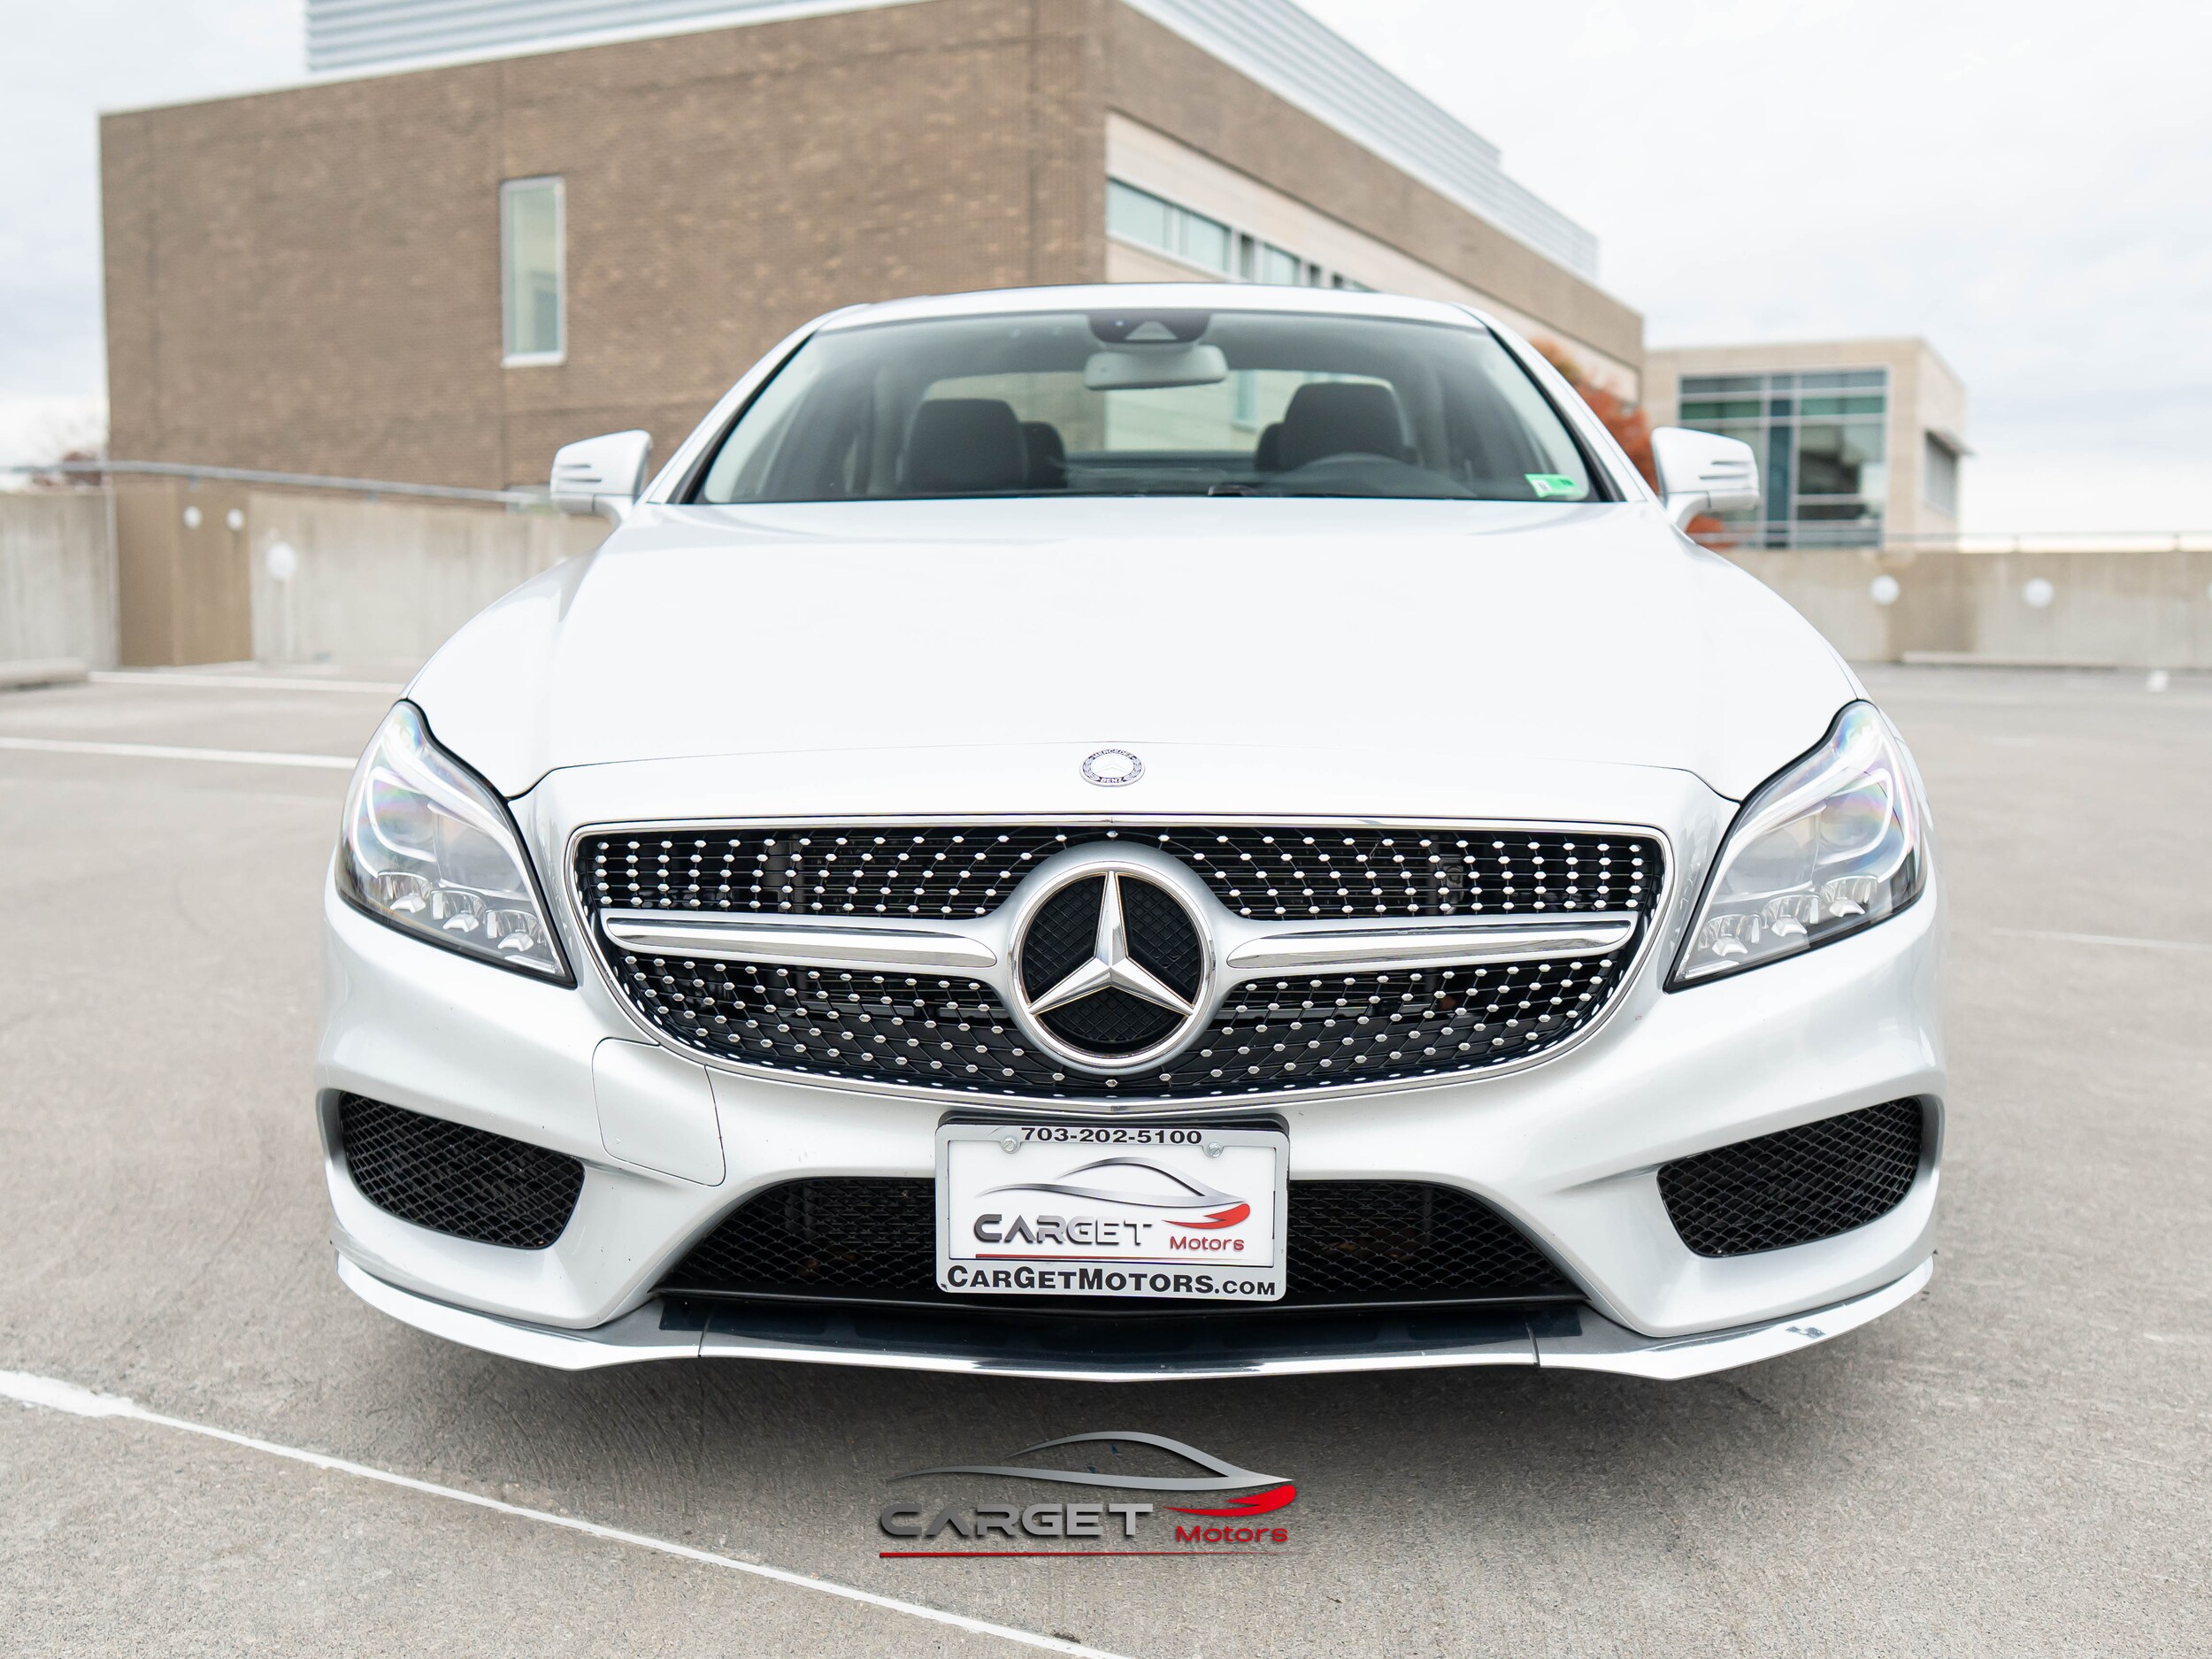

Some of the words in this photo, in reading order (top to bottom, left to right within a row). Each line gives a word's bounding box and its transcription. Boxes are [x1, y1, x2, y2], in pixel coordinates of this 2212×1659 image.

[1021, 1127, 1202, 1144] 703-202-5100
[973, 1213, 1151, 1246] CARGET
[1170, 1236, 1245, 1250] Motors
